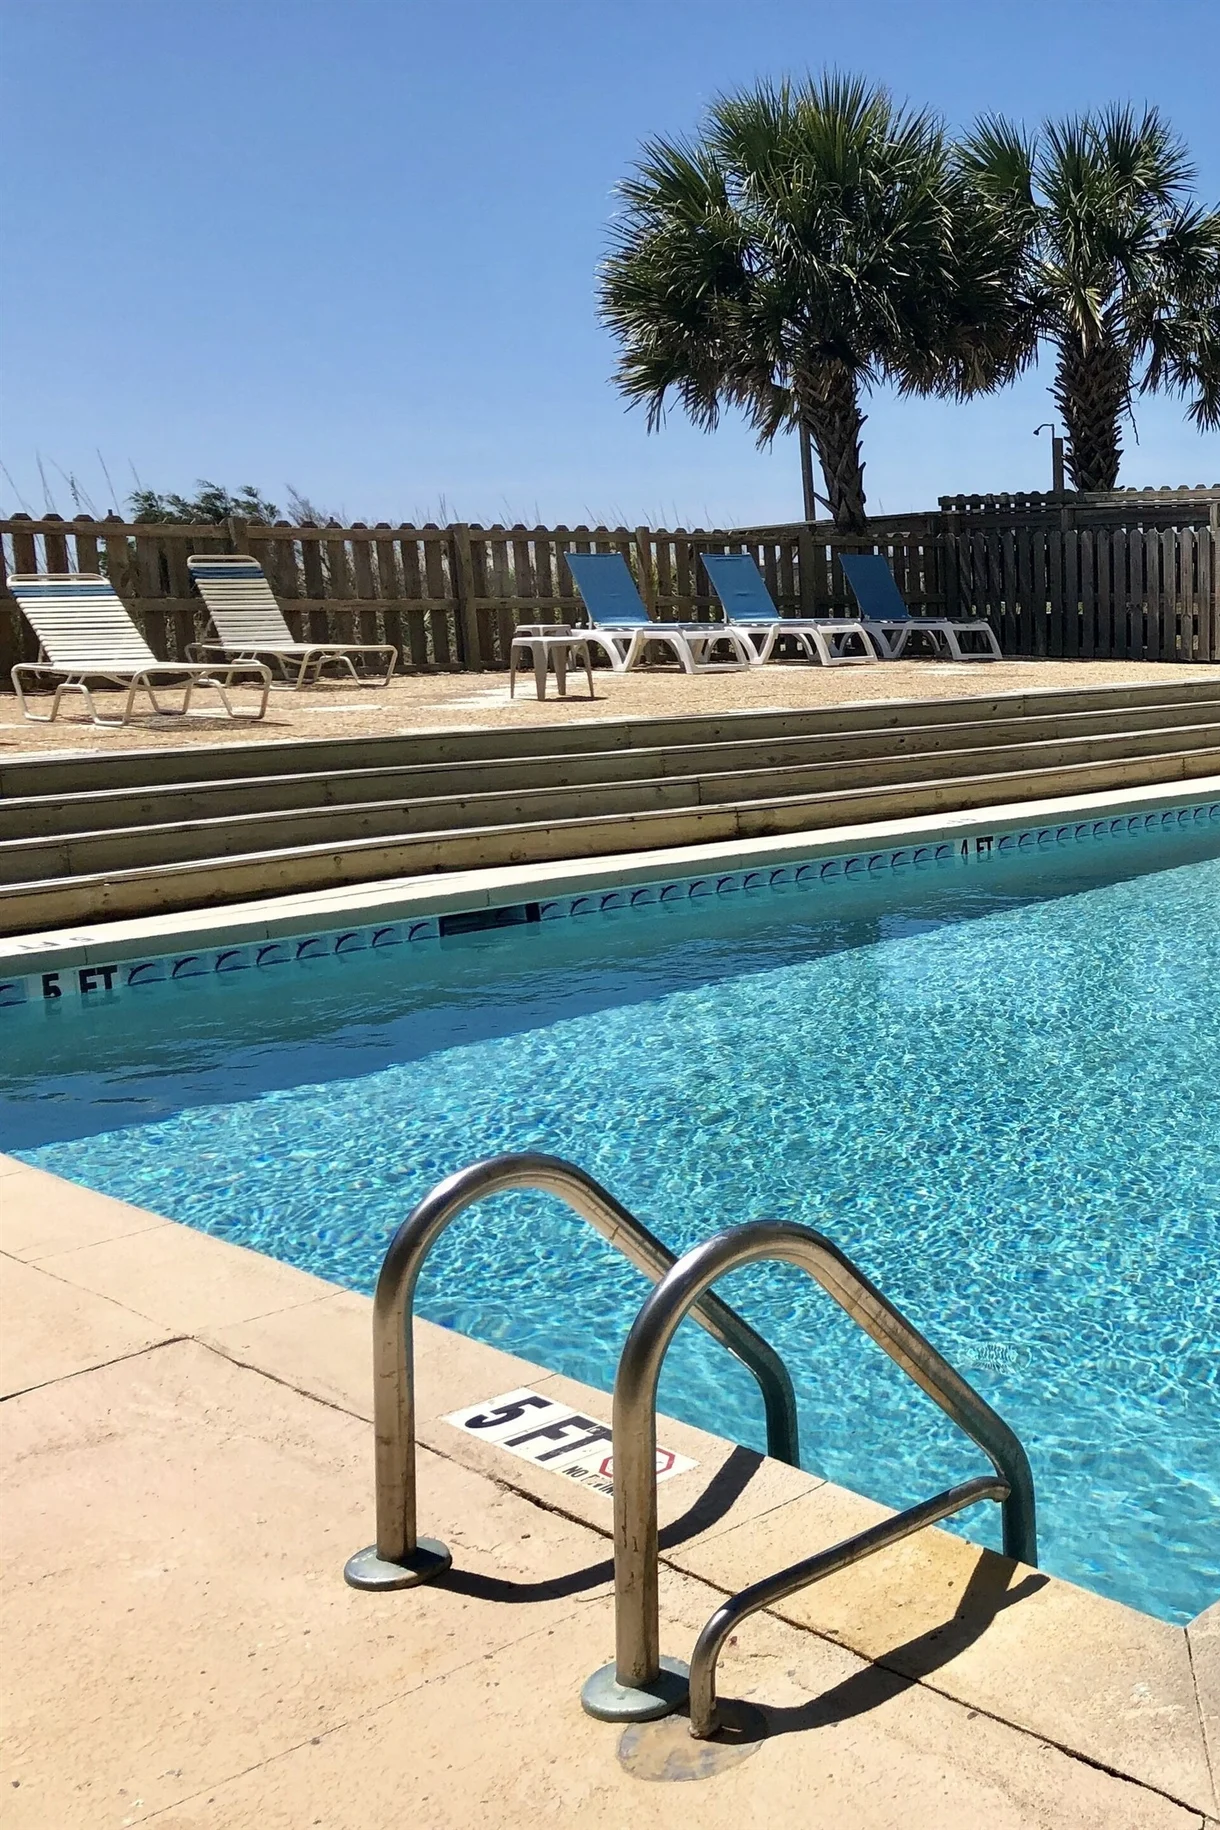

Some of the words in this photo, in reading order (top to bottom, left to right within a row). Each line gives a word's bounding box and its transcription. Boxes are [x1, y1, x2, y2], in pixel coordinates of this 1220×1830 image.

[42, 972, 62, 999] 5
[79, 965, 118, 994] FT
[464, 1395, 554, 1429] 5
[503, 1415, 613, 1462] FT
[561, 1465, 589, 1478] NO
